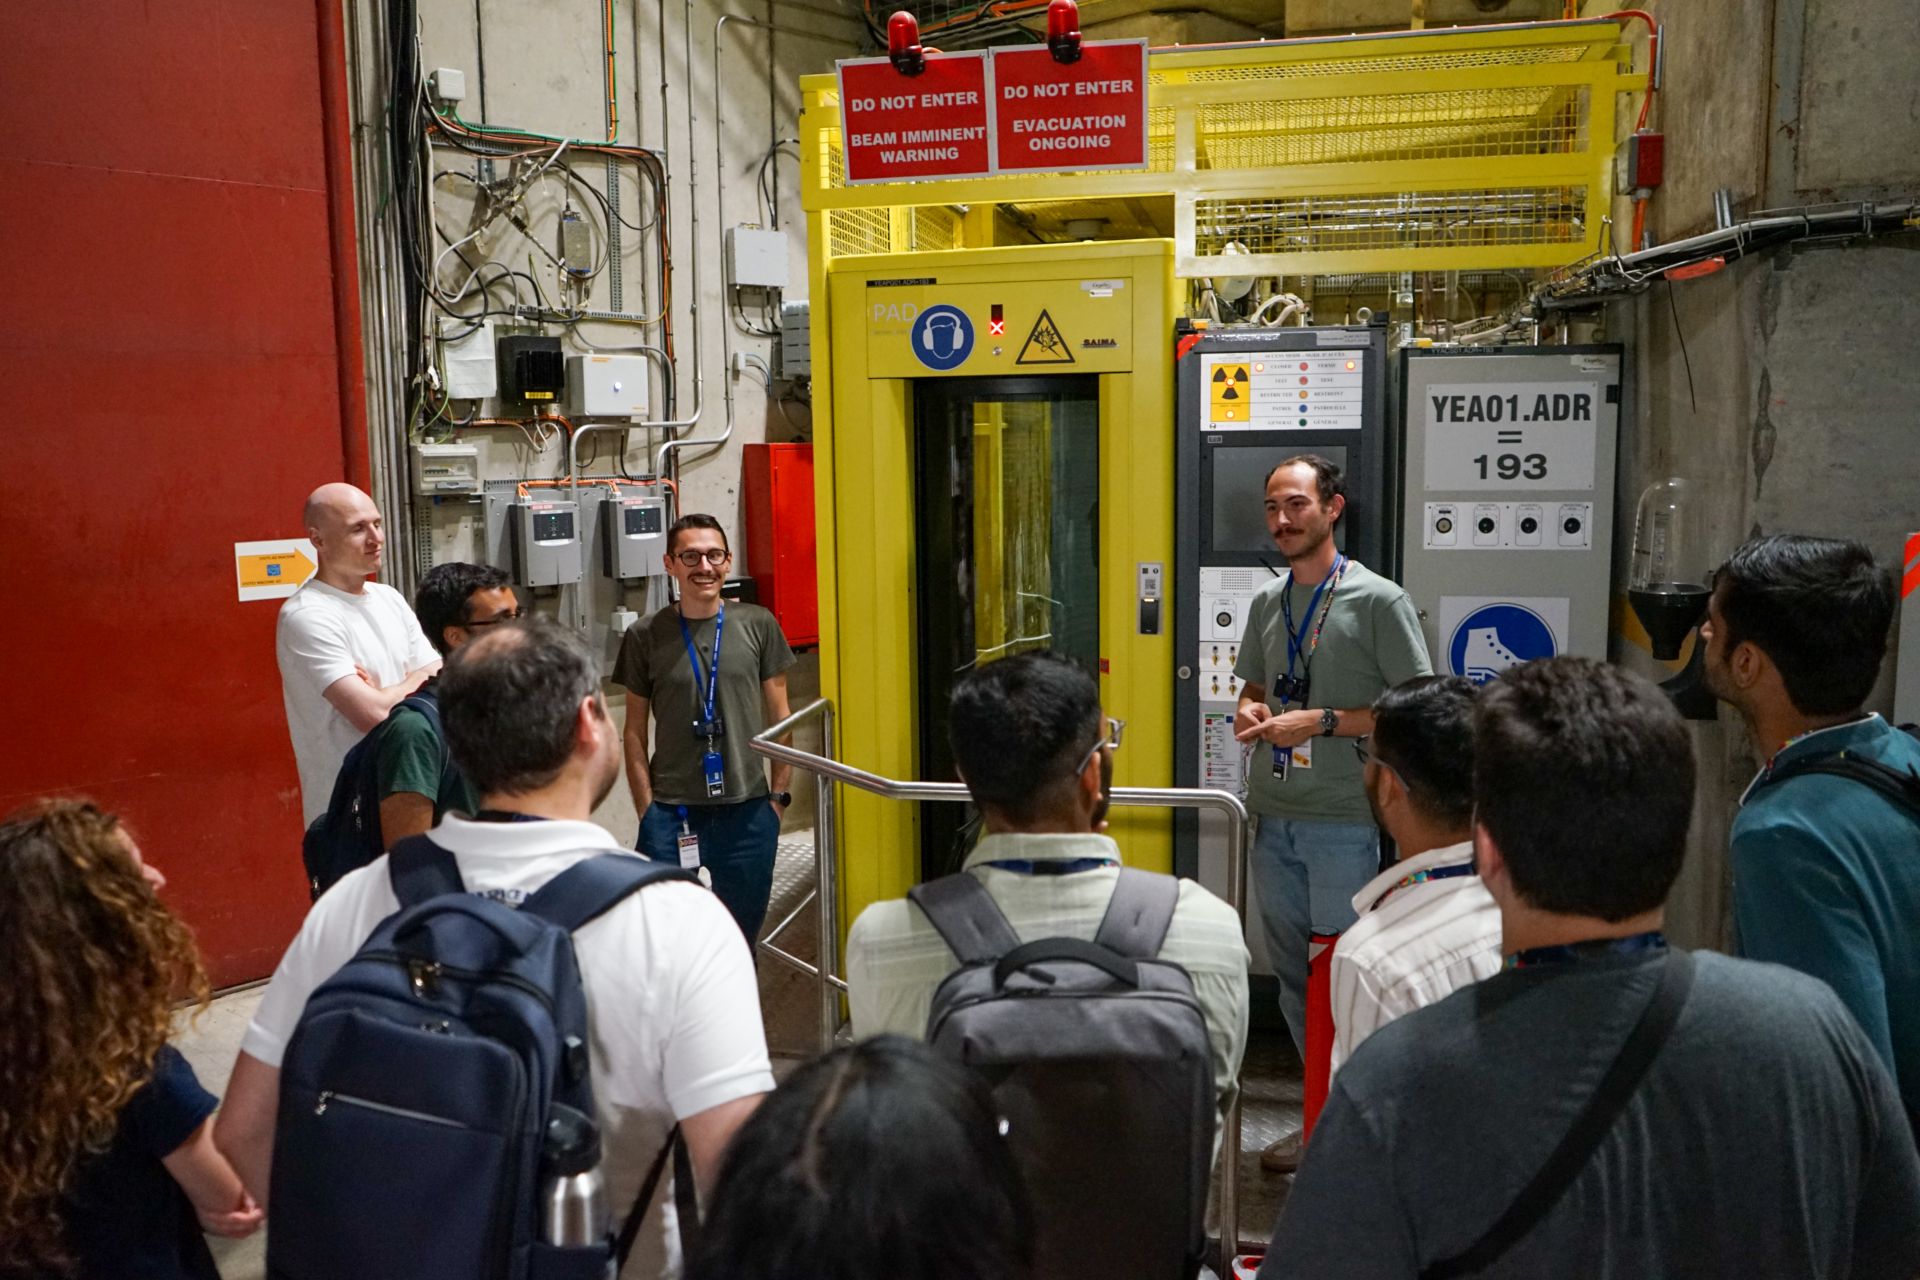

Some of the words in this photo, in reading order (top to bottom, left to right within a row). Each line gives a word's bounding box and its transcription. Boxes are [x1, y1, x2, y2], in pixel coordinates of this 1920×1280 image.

[1004, 85, 1028, 99] DO
[1033, 82, 1068, 97] NOT
[1074, 79, 1133, 95] ENTER
[852, 98, 874, 112] DO
[880, 95, 917, 110] NOT
[921, 91, 978, 108] ENTER
[1013, 115, 1126, 133] EVACUATION
[851, 132, 897, 147] BEAM
[901, 126, 985, 143] IMMINENT
[1029, 135, 1111, 151] ONGOING
[880, 147, 959, 164] WARNING
[874, 303, 918, 322] PAD
[1432, 393, 1591, 422] YEA01.ADR
[1473, 454, 1547, 480] 193
